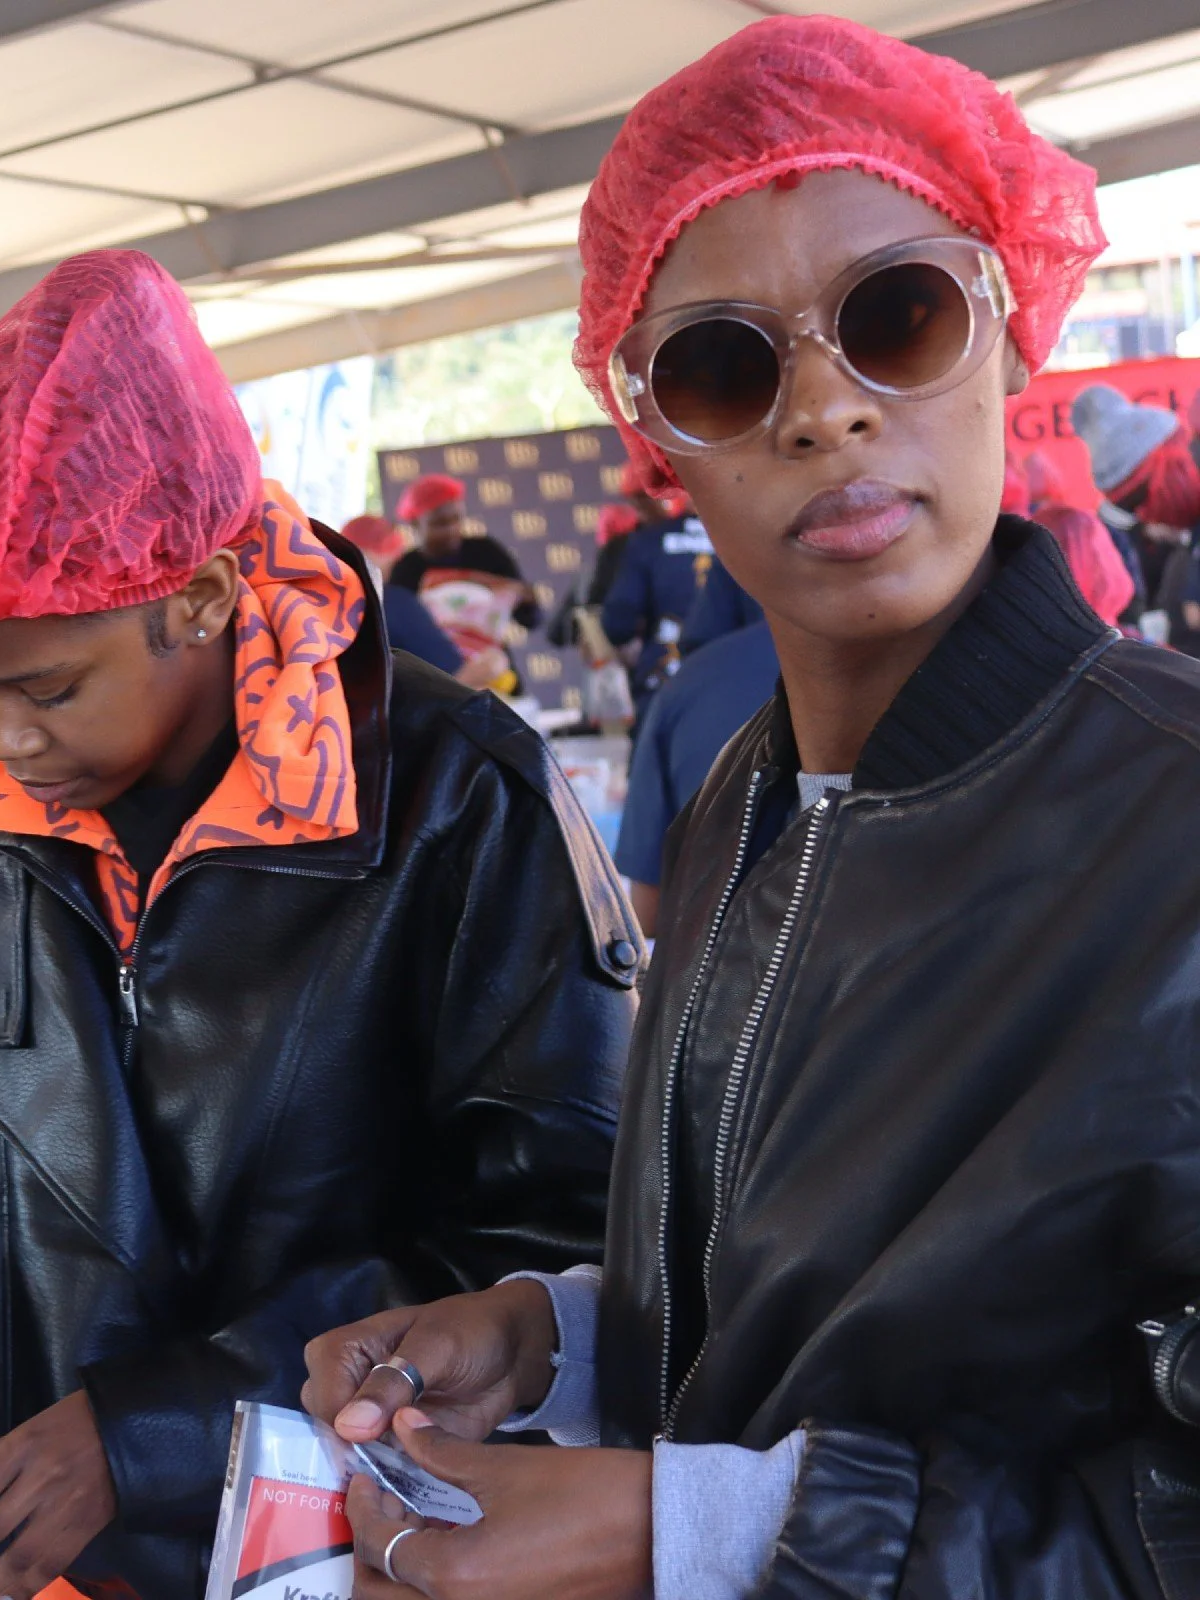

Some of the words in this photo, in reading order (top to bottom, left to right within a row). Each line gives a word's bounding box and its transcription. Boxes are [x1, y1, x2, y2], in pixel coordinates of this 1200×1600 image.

[263, 1487, 297, 1505] NOT
[300, 1494, 331, 1512] FOR
[334, 1501, 344, 1515] R
